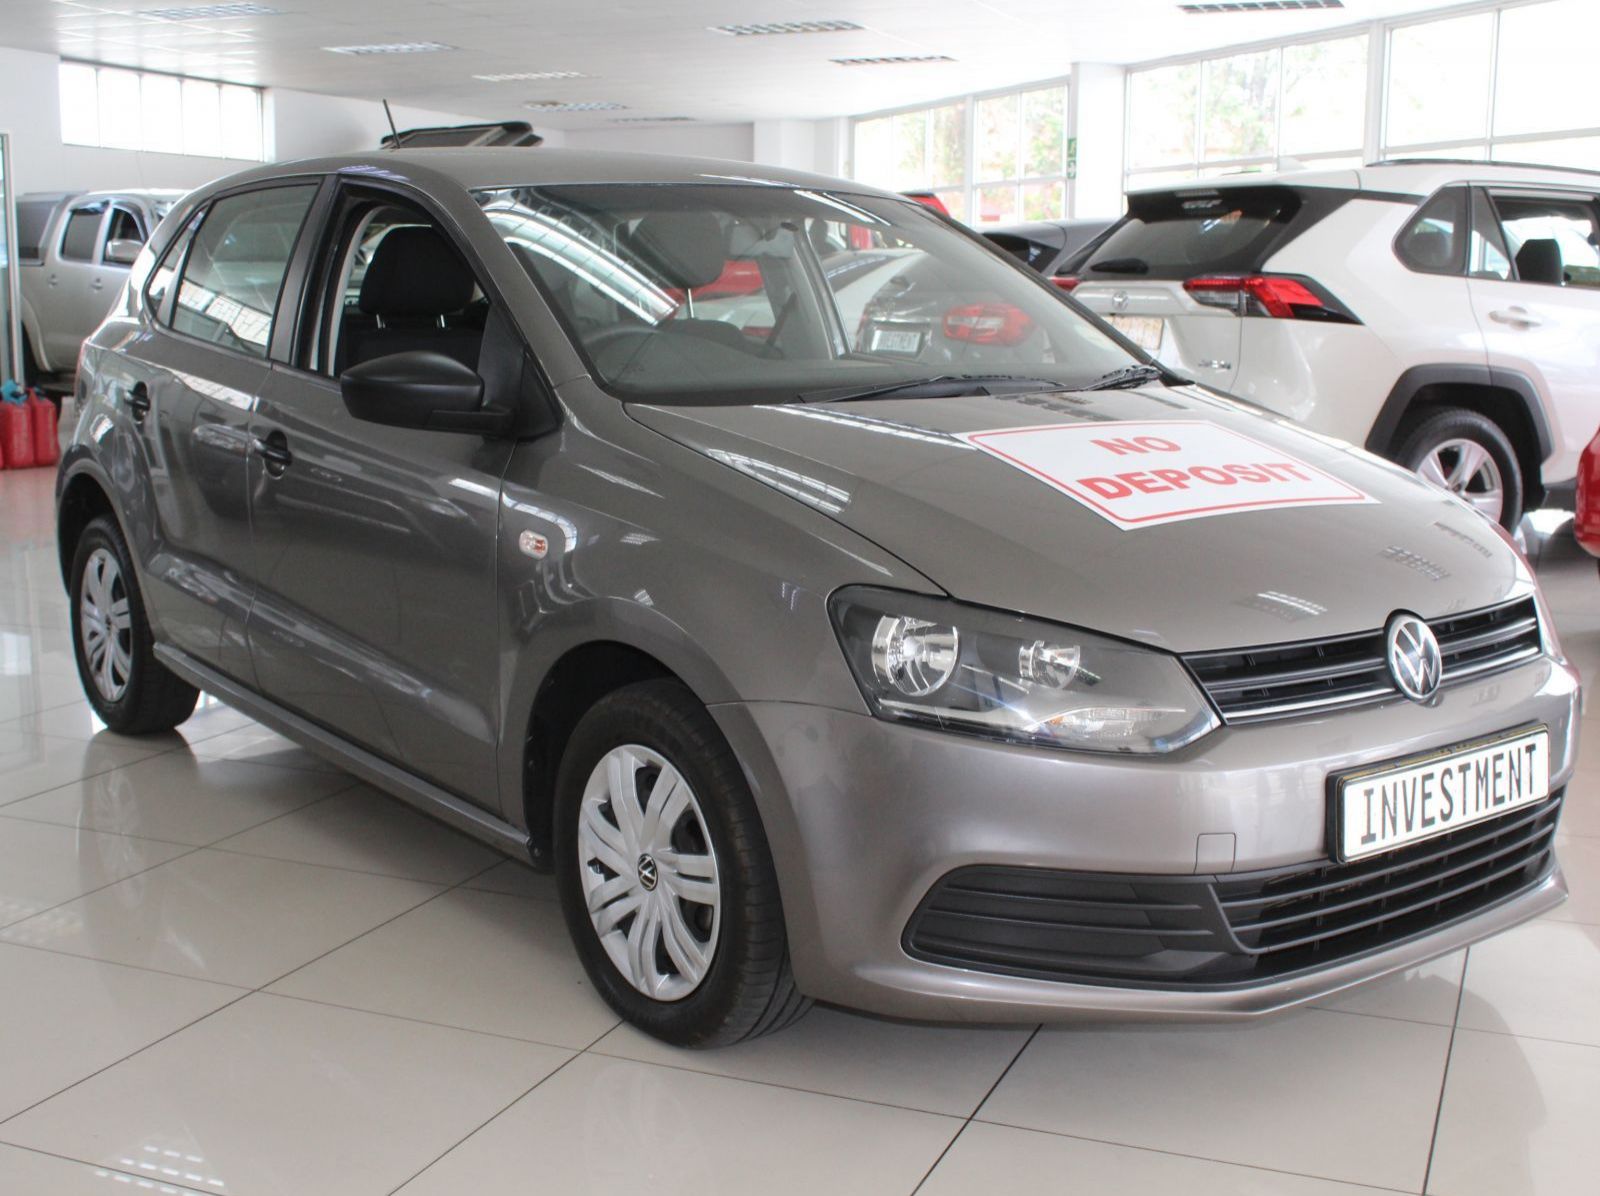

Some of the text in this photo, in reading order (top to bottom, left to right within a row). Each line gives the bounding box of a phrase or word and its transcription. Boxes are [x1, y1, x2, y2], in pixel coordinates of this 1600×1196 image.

[1090, 436, 1181, 456] NO
[1076, 462, 1311, 500] DEPOSIT
[1360, 743, 1536, 845] INVESTMENT
